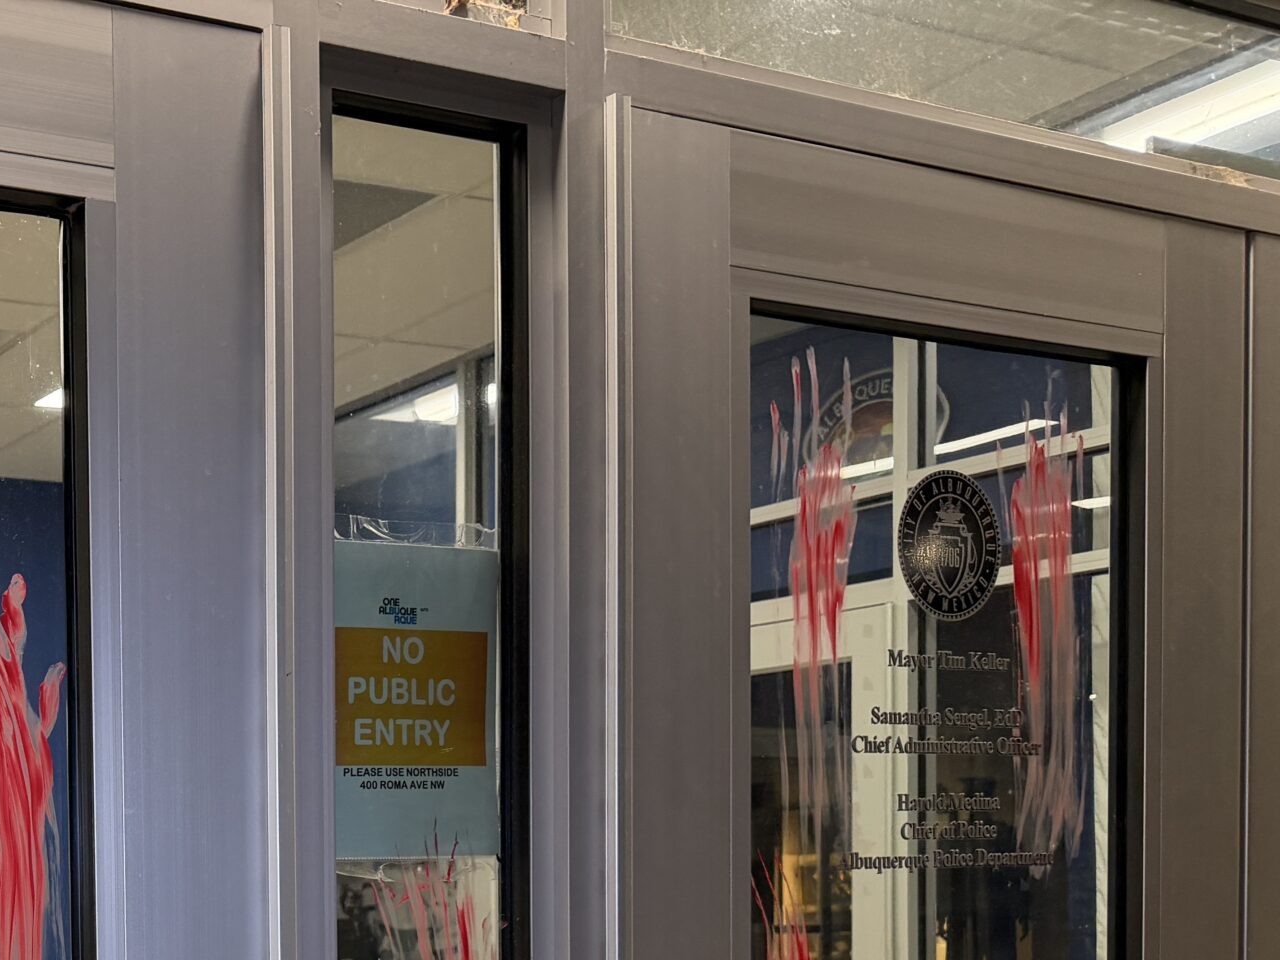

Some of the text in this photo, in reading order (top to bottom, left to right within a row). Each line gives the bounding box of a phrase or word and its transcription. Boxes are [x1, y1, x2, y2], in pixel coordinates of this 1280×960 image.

[382, 635, 425, 665] NO
[887, 649, 1011, 672] Mayor Tim Keller
[347, 676, 456, 706] PUBLIC
[870, 706, 942, 726] Samantha
[944, 707, 992, 731] Sengel,
[354, 718, 450, 746] ENTRY
[851, 735, 1042, 756] Chief Administrative Officer
[343, 768, 459, 777] PLEASE USE NORTHSIDE
[360, 780, 445, 790] 400 ROMA AVE NW
[897, 793, 1000, 812] Harold Medina
[900, 821, 998, 841] Chief of Police
[840, 849, 1054, 874] Albuquerque Police Department
